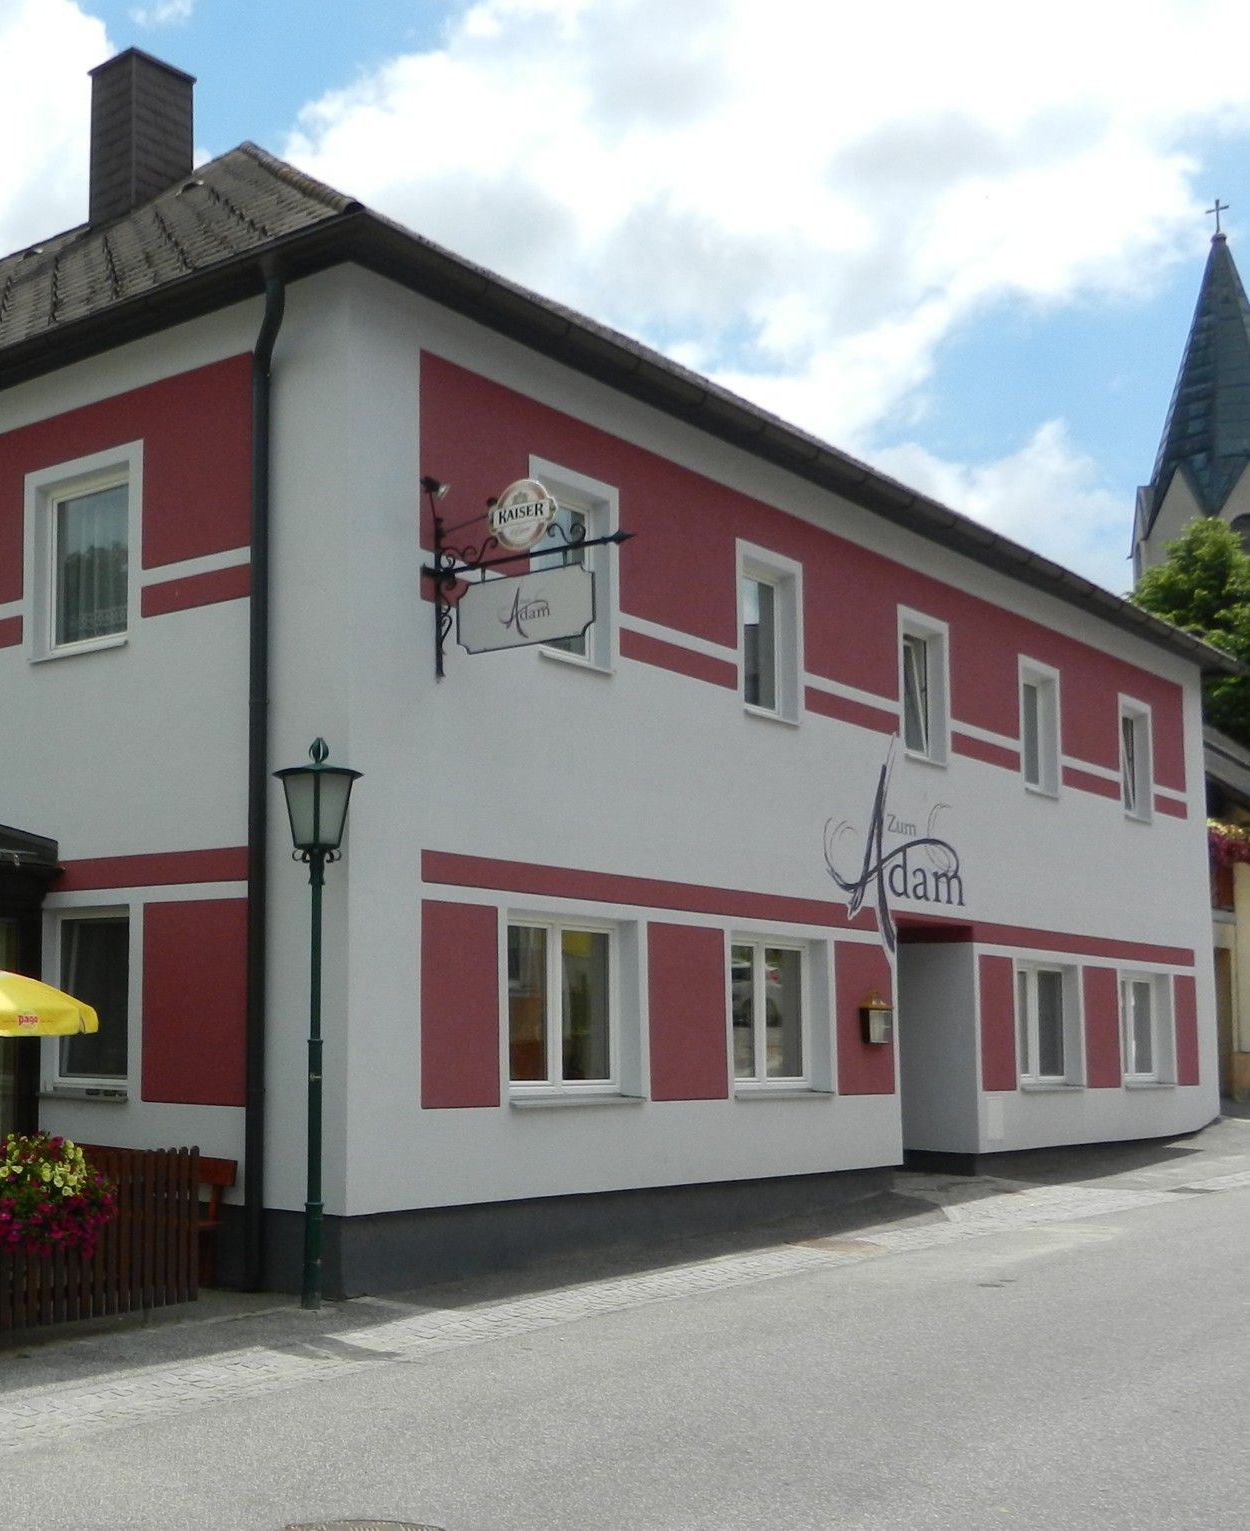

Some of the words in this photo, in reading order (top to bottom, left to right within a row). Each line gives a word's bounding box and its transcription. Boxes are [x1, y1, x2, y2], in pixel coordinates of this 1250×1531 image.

[498, 502, 544, 525] KAISER
[500, 587, 550, 639] Adam
[887, 814, 917, 837] Zum
[825, 745, 965, 953] Adam
